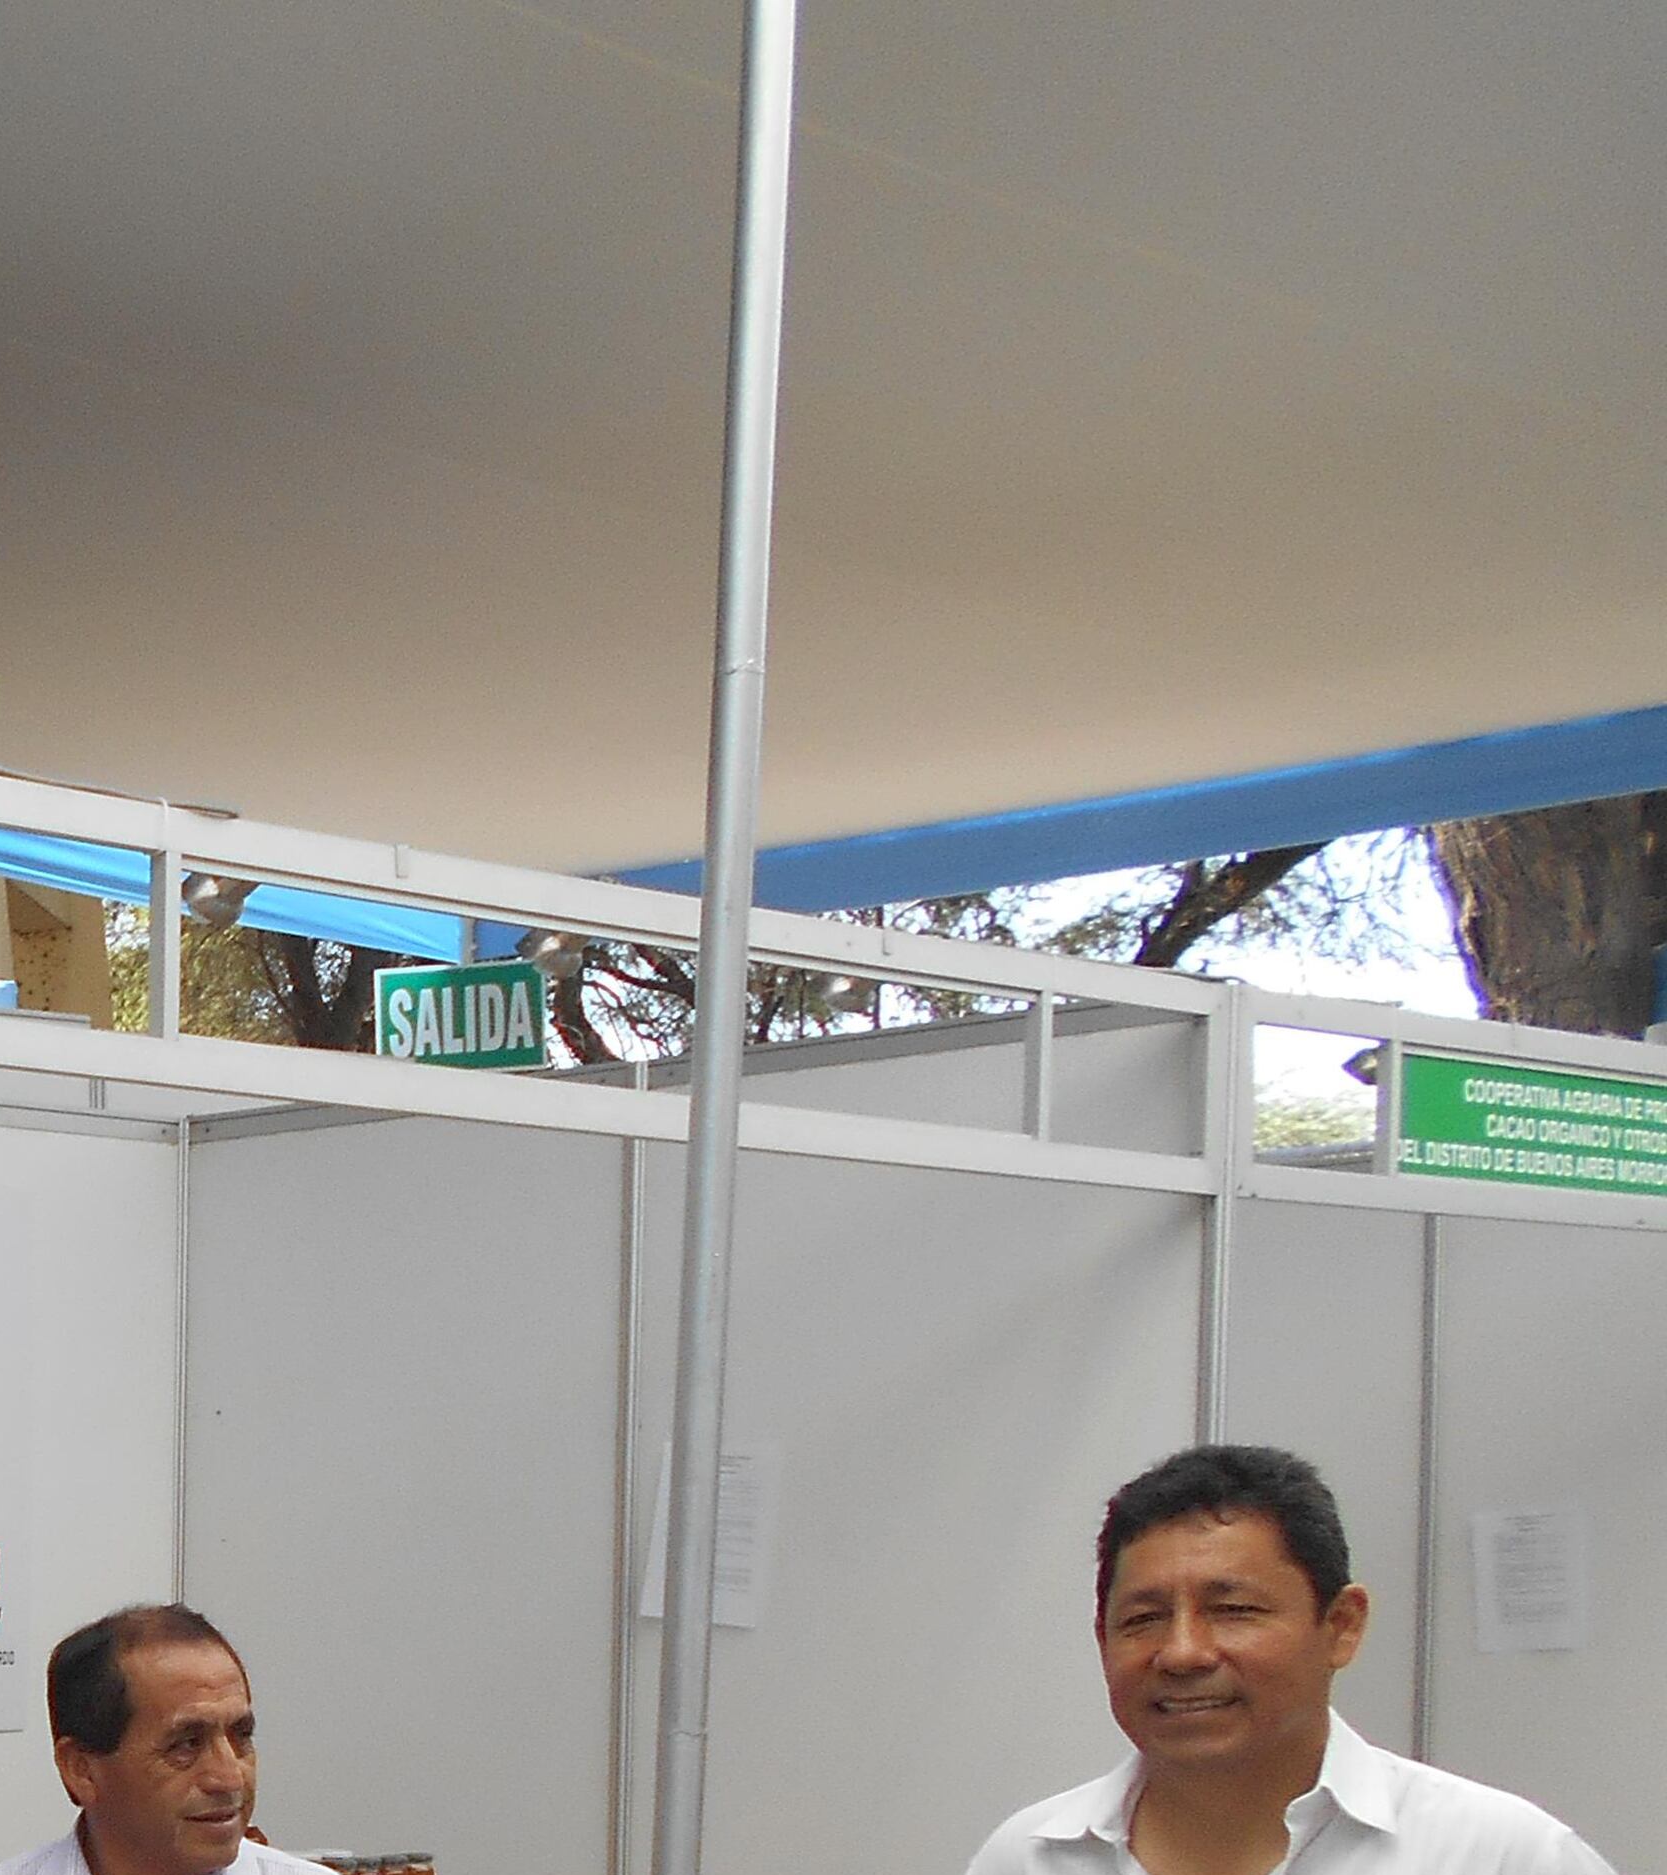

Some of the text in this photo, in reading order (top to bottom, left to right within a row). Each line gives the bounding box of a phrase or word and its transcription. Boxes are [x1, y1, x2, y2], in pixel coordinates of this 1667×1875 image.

[388, 982, 535, 1058] SALIDA
[1465, 1079, 1559, 1110] COOPERATIVA
[1624, 1097, 1643, 1120] DE
[1486, 1114, 1535, 1140] CACAO
[1539, 1119, 1611, 1148] ORGANICO
[1612, 1126, 1623, 1149] Y
[1426, 1141, 1492, 1170] DISTRITO
[1494, 1148, 1514, 1172] DE
[1516, 1150, 1574, 1176] BUENOS
[1575, 1156, 1615, 1180] AIRES
